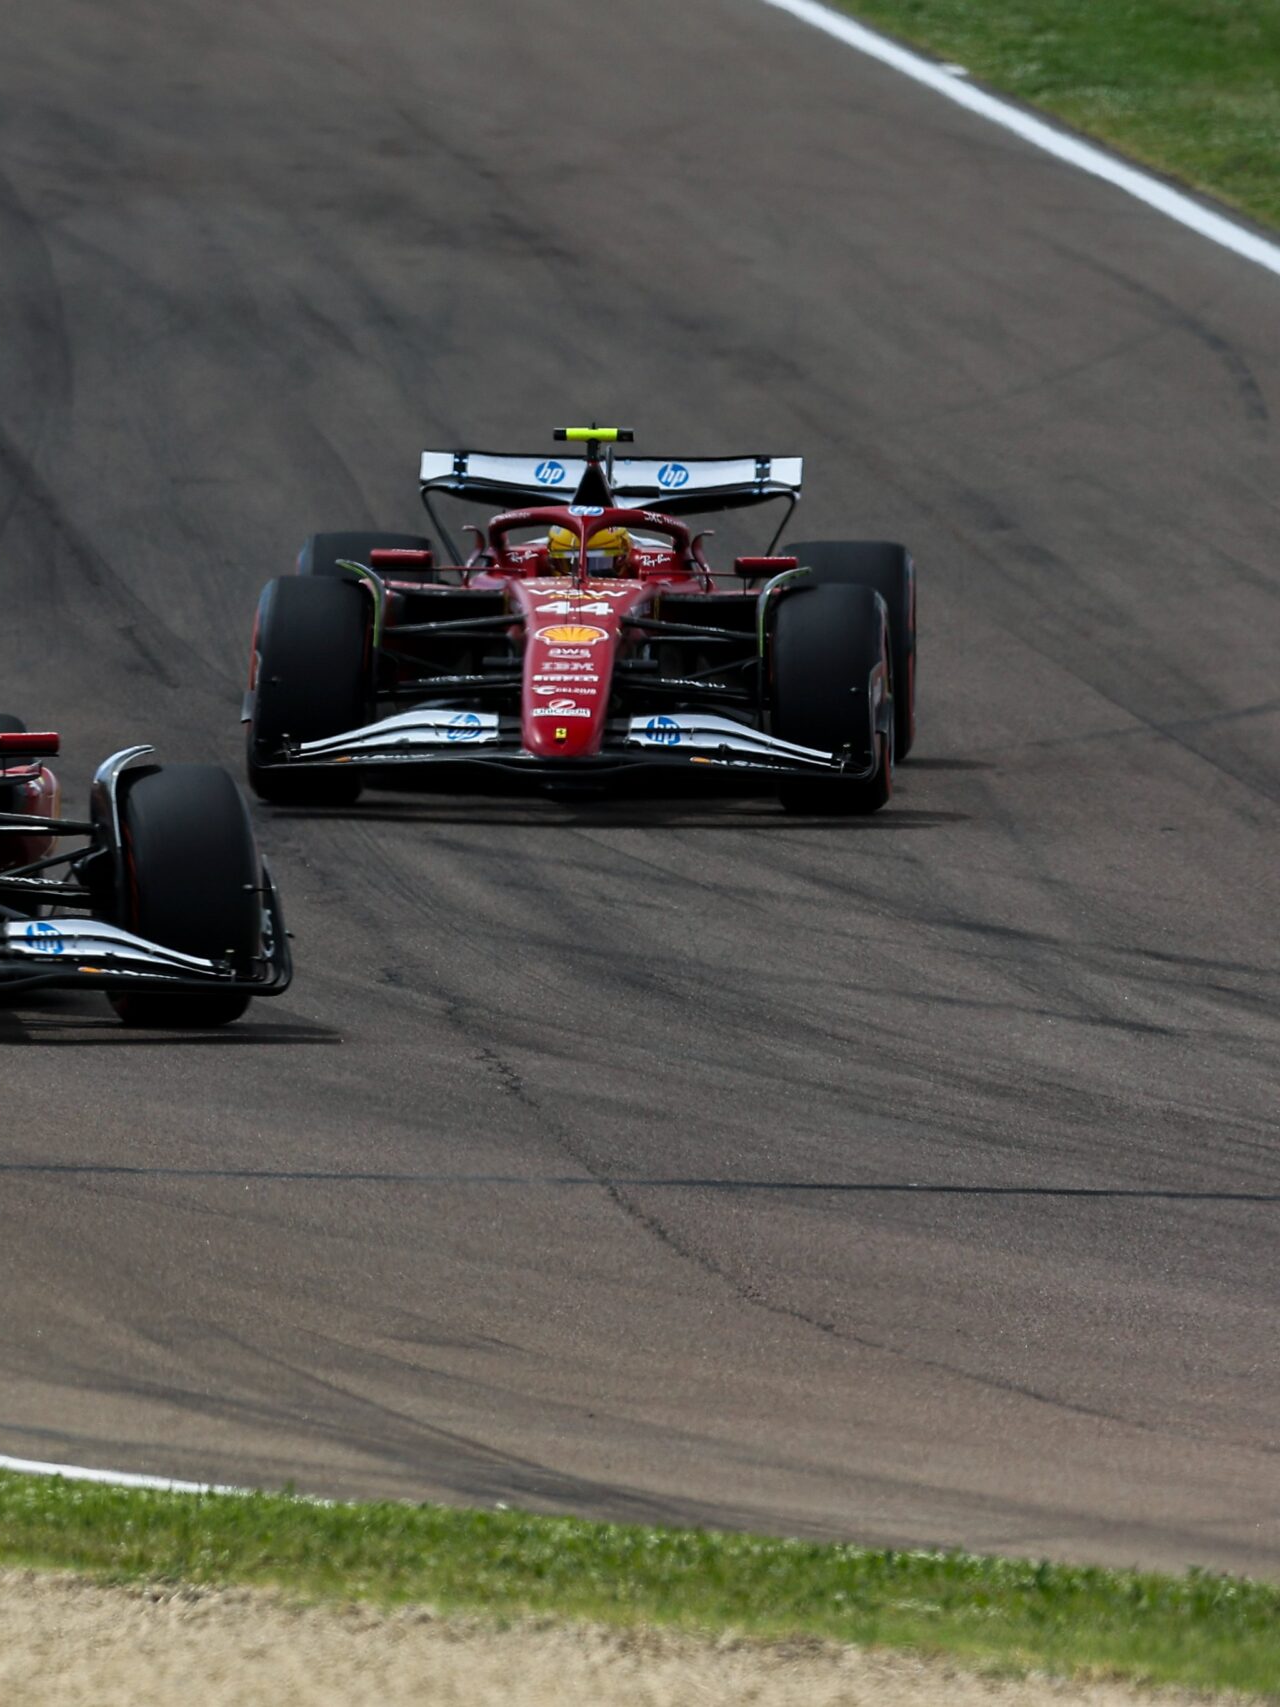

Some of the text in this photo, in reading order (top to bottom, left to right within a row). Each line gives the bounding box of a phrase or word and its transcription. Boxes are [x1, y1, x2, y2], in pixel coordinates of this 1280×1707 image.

[537, 461, 563, 484] hp
[661, 463, 687, 487] hp
[535, 601, 613, 615] 44
[549, 648, 590, 657] aws
[542, 662, 594, 671] IBM
[652, 716, 681, 745] hp
[29, 923, 63, 954] hp
